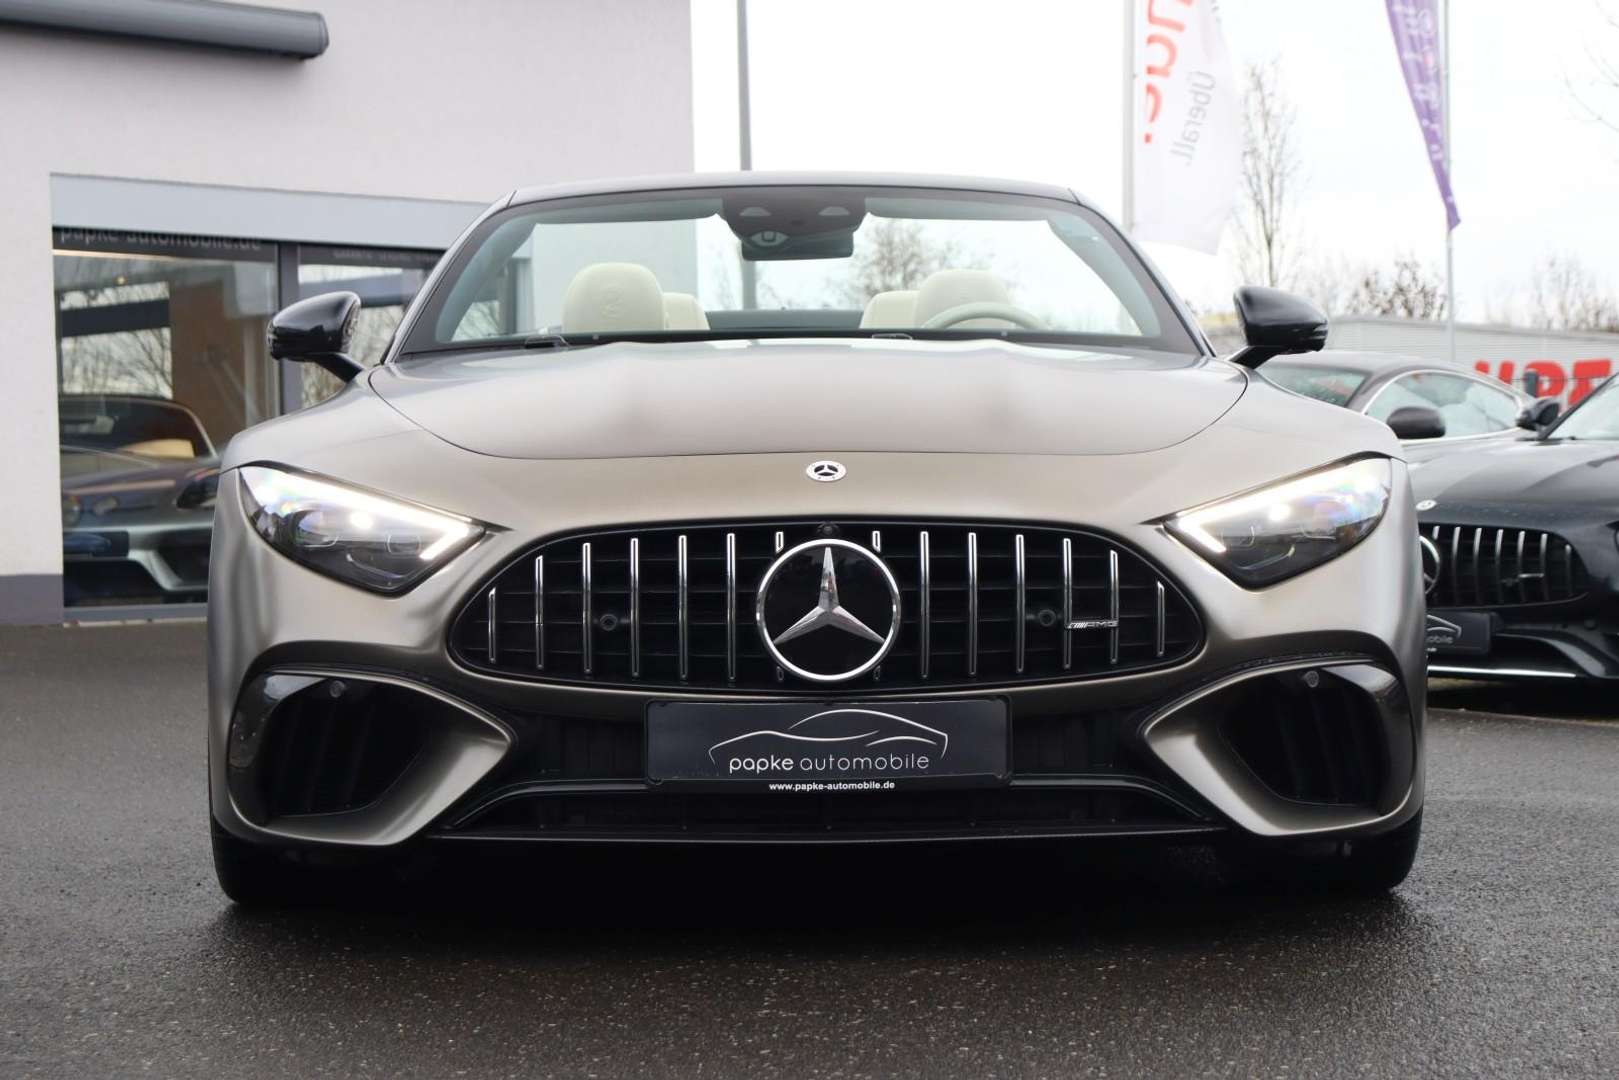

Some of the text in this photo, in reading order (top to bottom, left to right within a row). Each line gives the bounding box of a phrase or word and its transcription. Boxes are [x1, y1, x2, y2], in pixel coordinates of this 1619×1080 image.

[729, 753, 930, 774] papke automobile
[768, 780, 896, 792] www.papke-automobile.de
